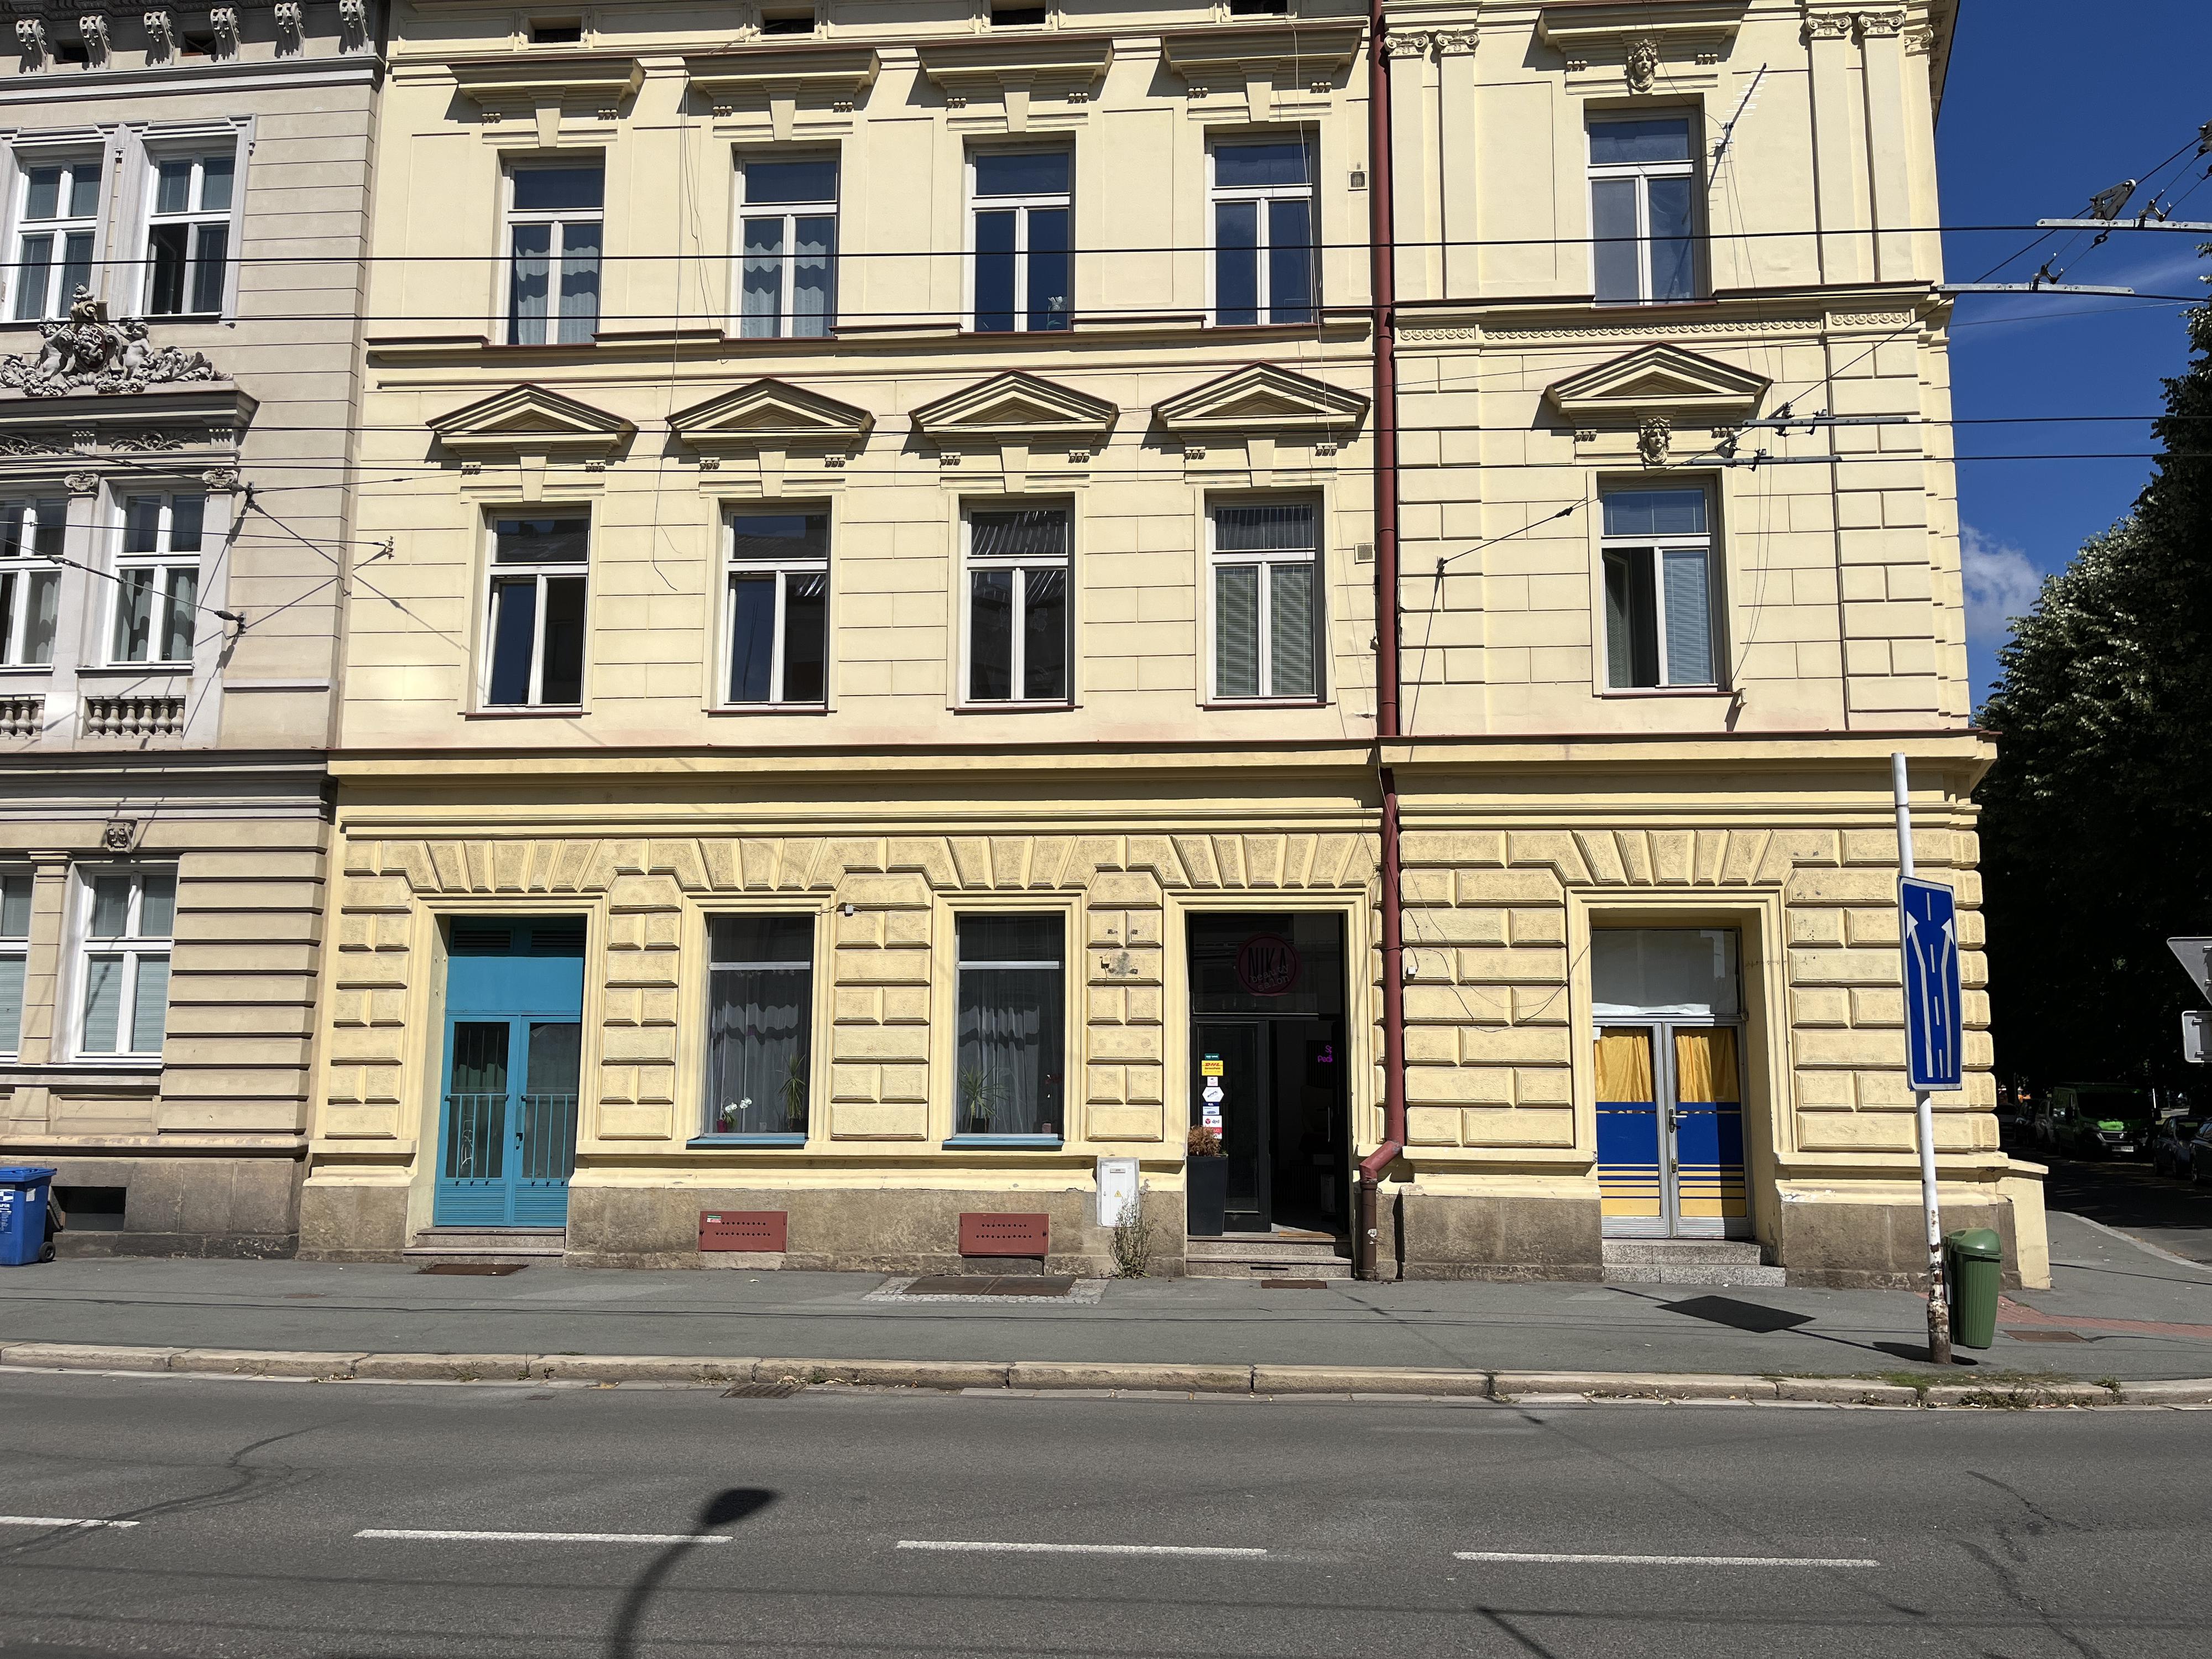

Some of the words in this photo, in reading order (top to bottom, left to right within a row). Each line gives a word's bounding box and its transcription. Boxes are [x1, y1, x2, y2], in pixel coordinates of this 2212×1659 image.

[1248, 947, 1288, 983] NIKA
[1249, 964, 1288, 983] beauty
[1258, 974, 1290, 992] salon
